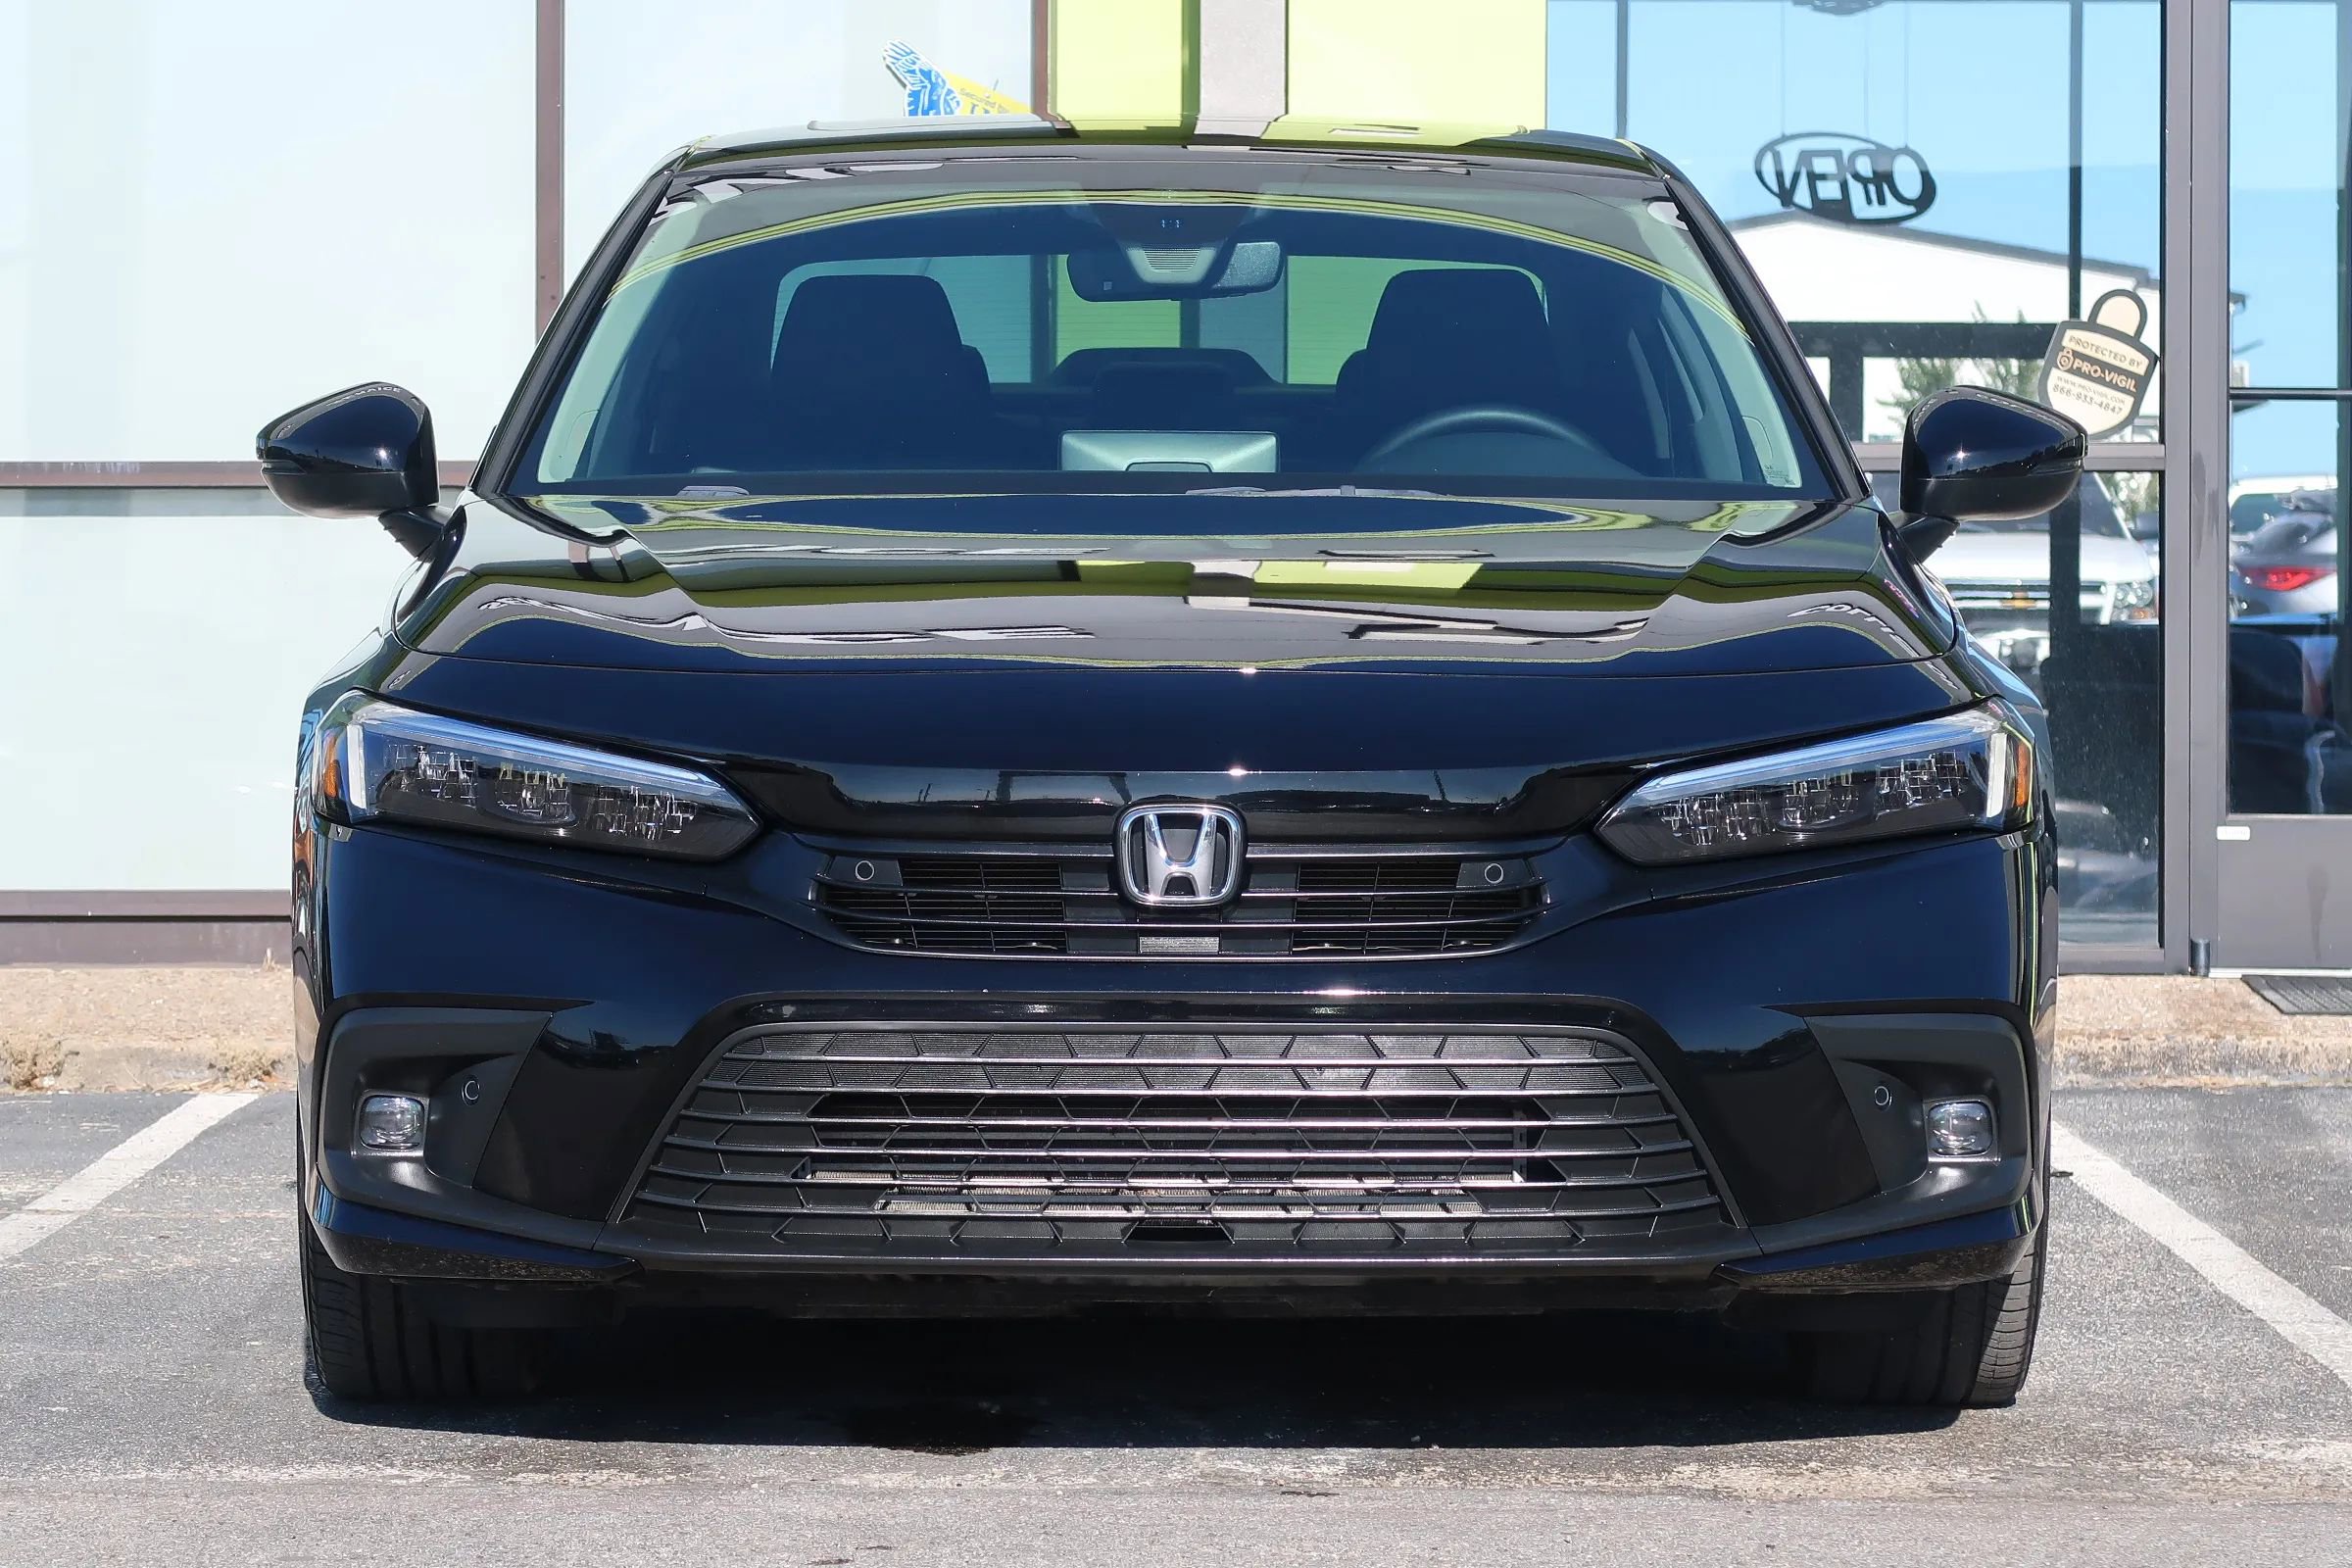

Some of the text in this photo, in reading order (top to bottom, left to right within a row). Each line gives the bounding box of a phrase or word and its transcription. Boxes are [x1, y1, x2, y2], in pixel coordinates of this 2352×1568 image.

[2069, 335, 2143, 368] PROTECTED BY
[2072, 357, 2136, 392] PRO-VIGIL
